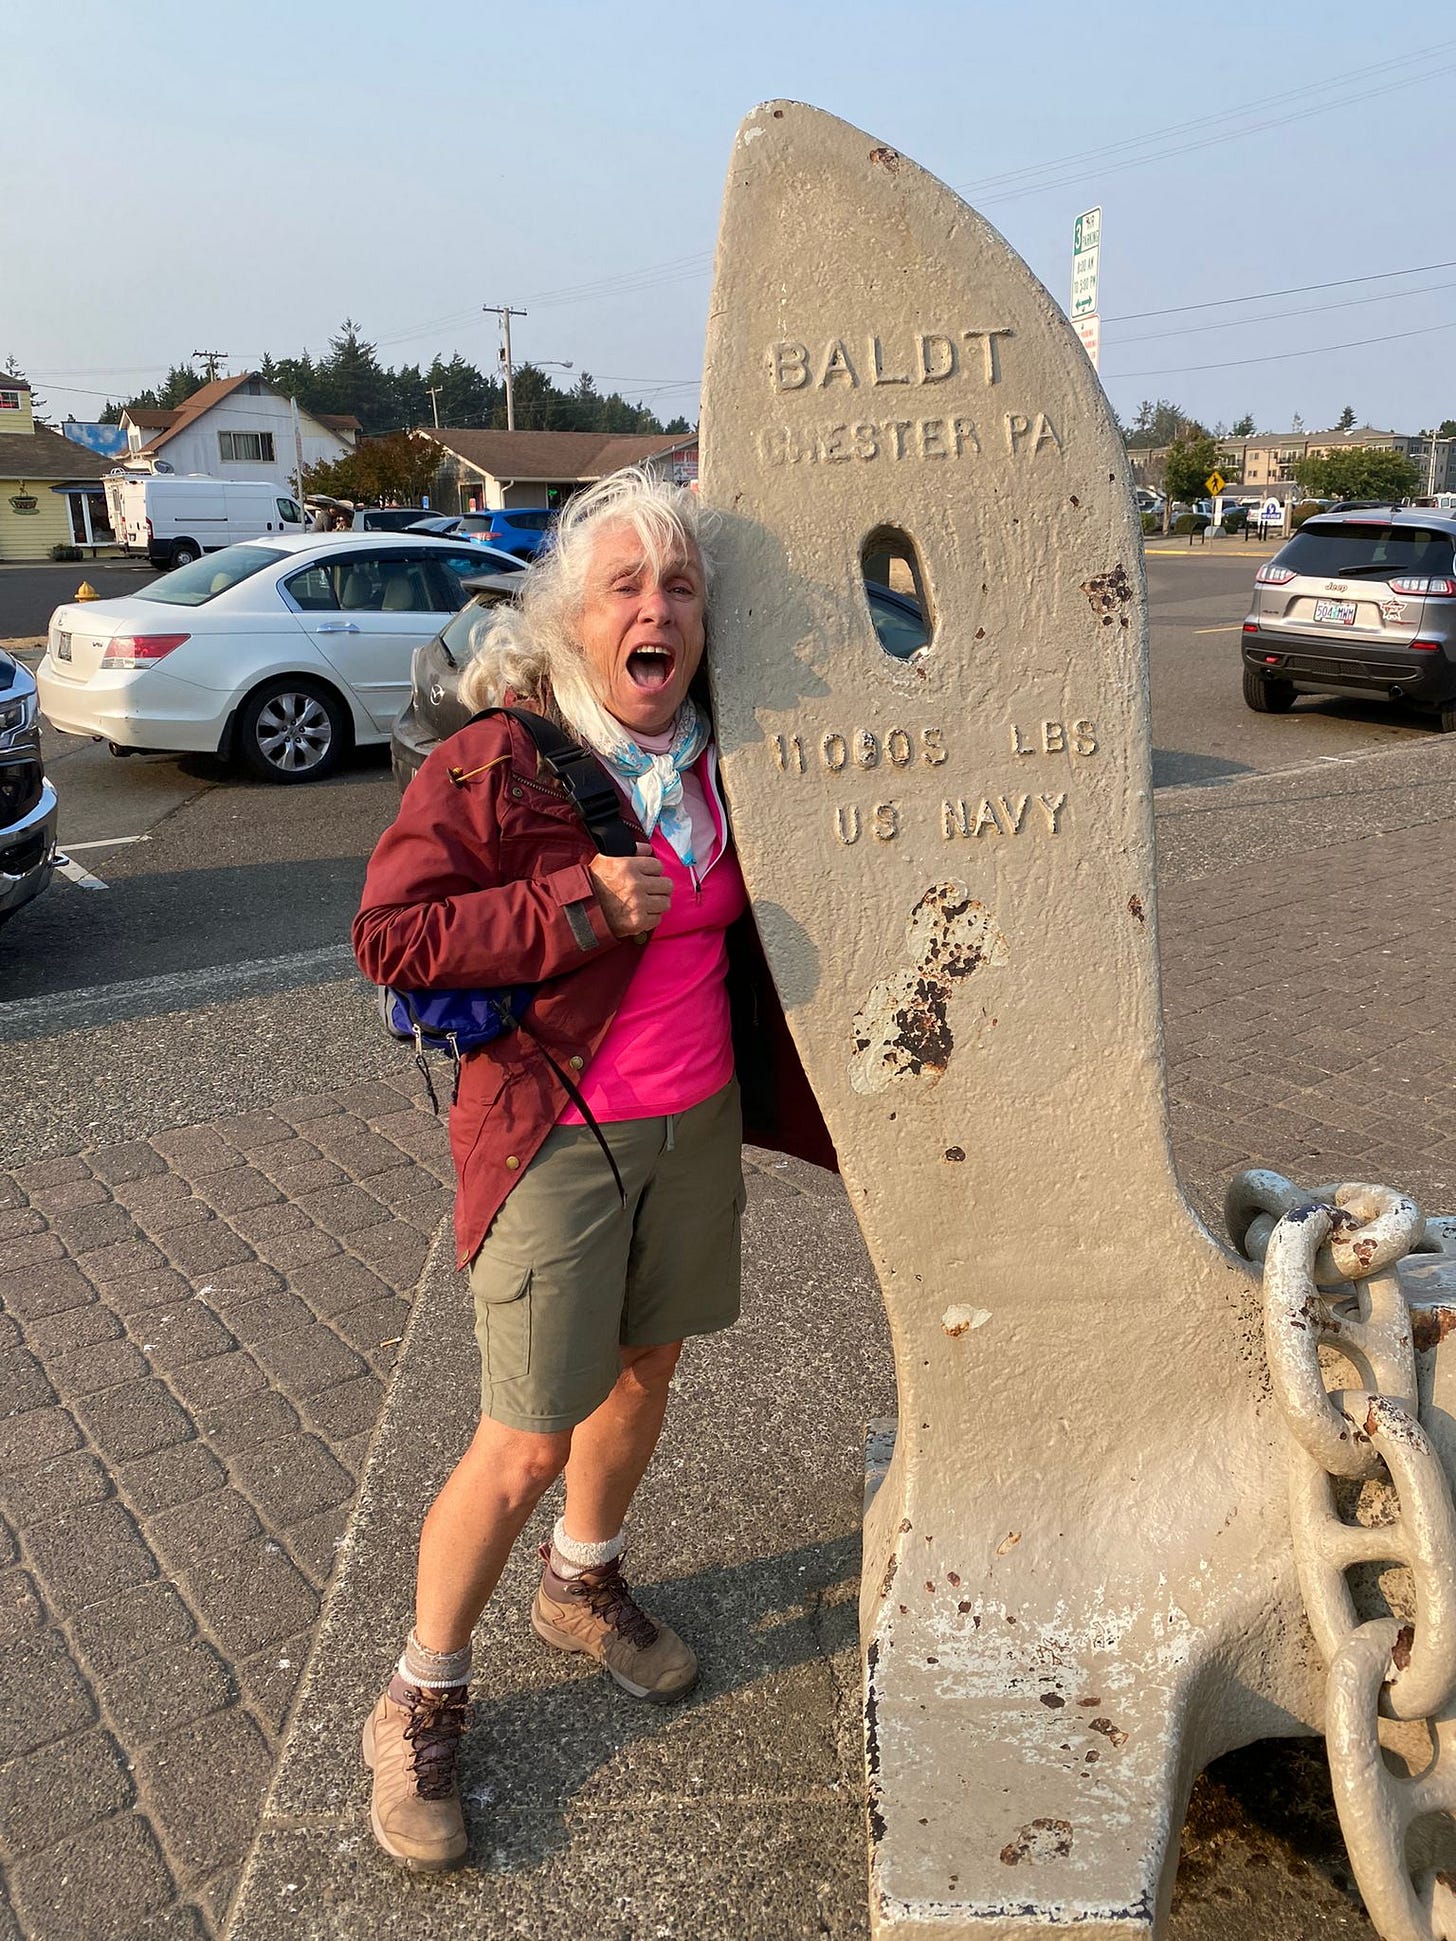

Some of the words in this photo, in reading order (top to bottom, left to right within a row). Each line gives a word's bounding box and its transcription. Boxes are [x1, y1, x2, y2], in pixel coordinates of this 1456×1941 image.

[1075, 223, 1082, 249] 3
[768, 327, 1012, 393] BALDT
[757, 417, 982, 466] CHESTER
[1003, 410, 1063, 460] PA
[1324, 581, 1349, 593] Jeep
[1317, 604, 1333, 618] 504
[1009, 718, 1098, 757] LBS
[835, 803, 898, 846] US
[940, 792, 1069, 840] NAVY
